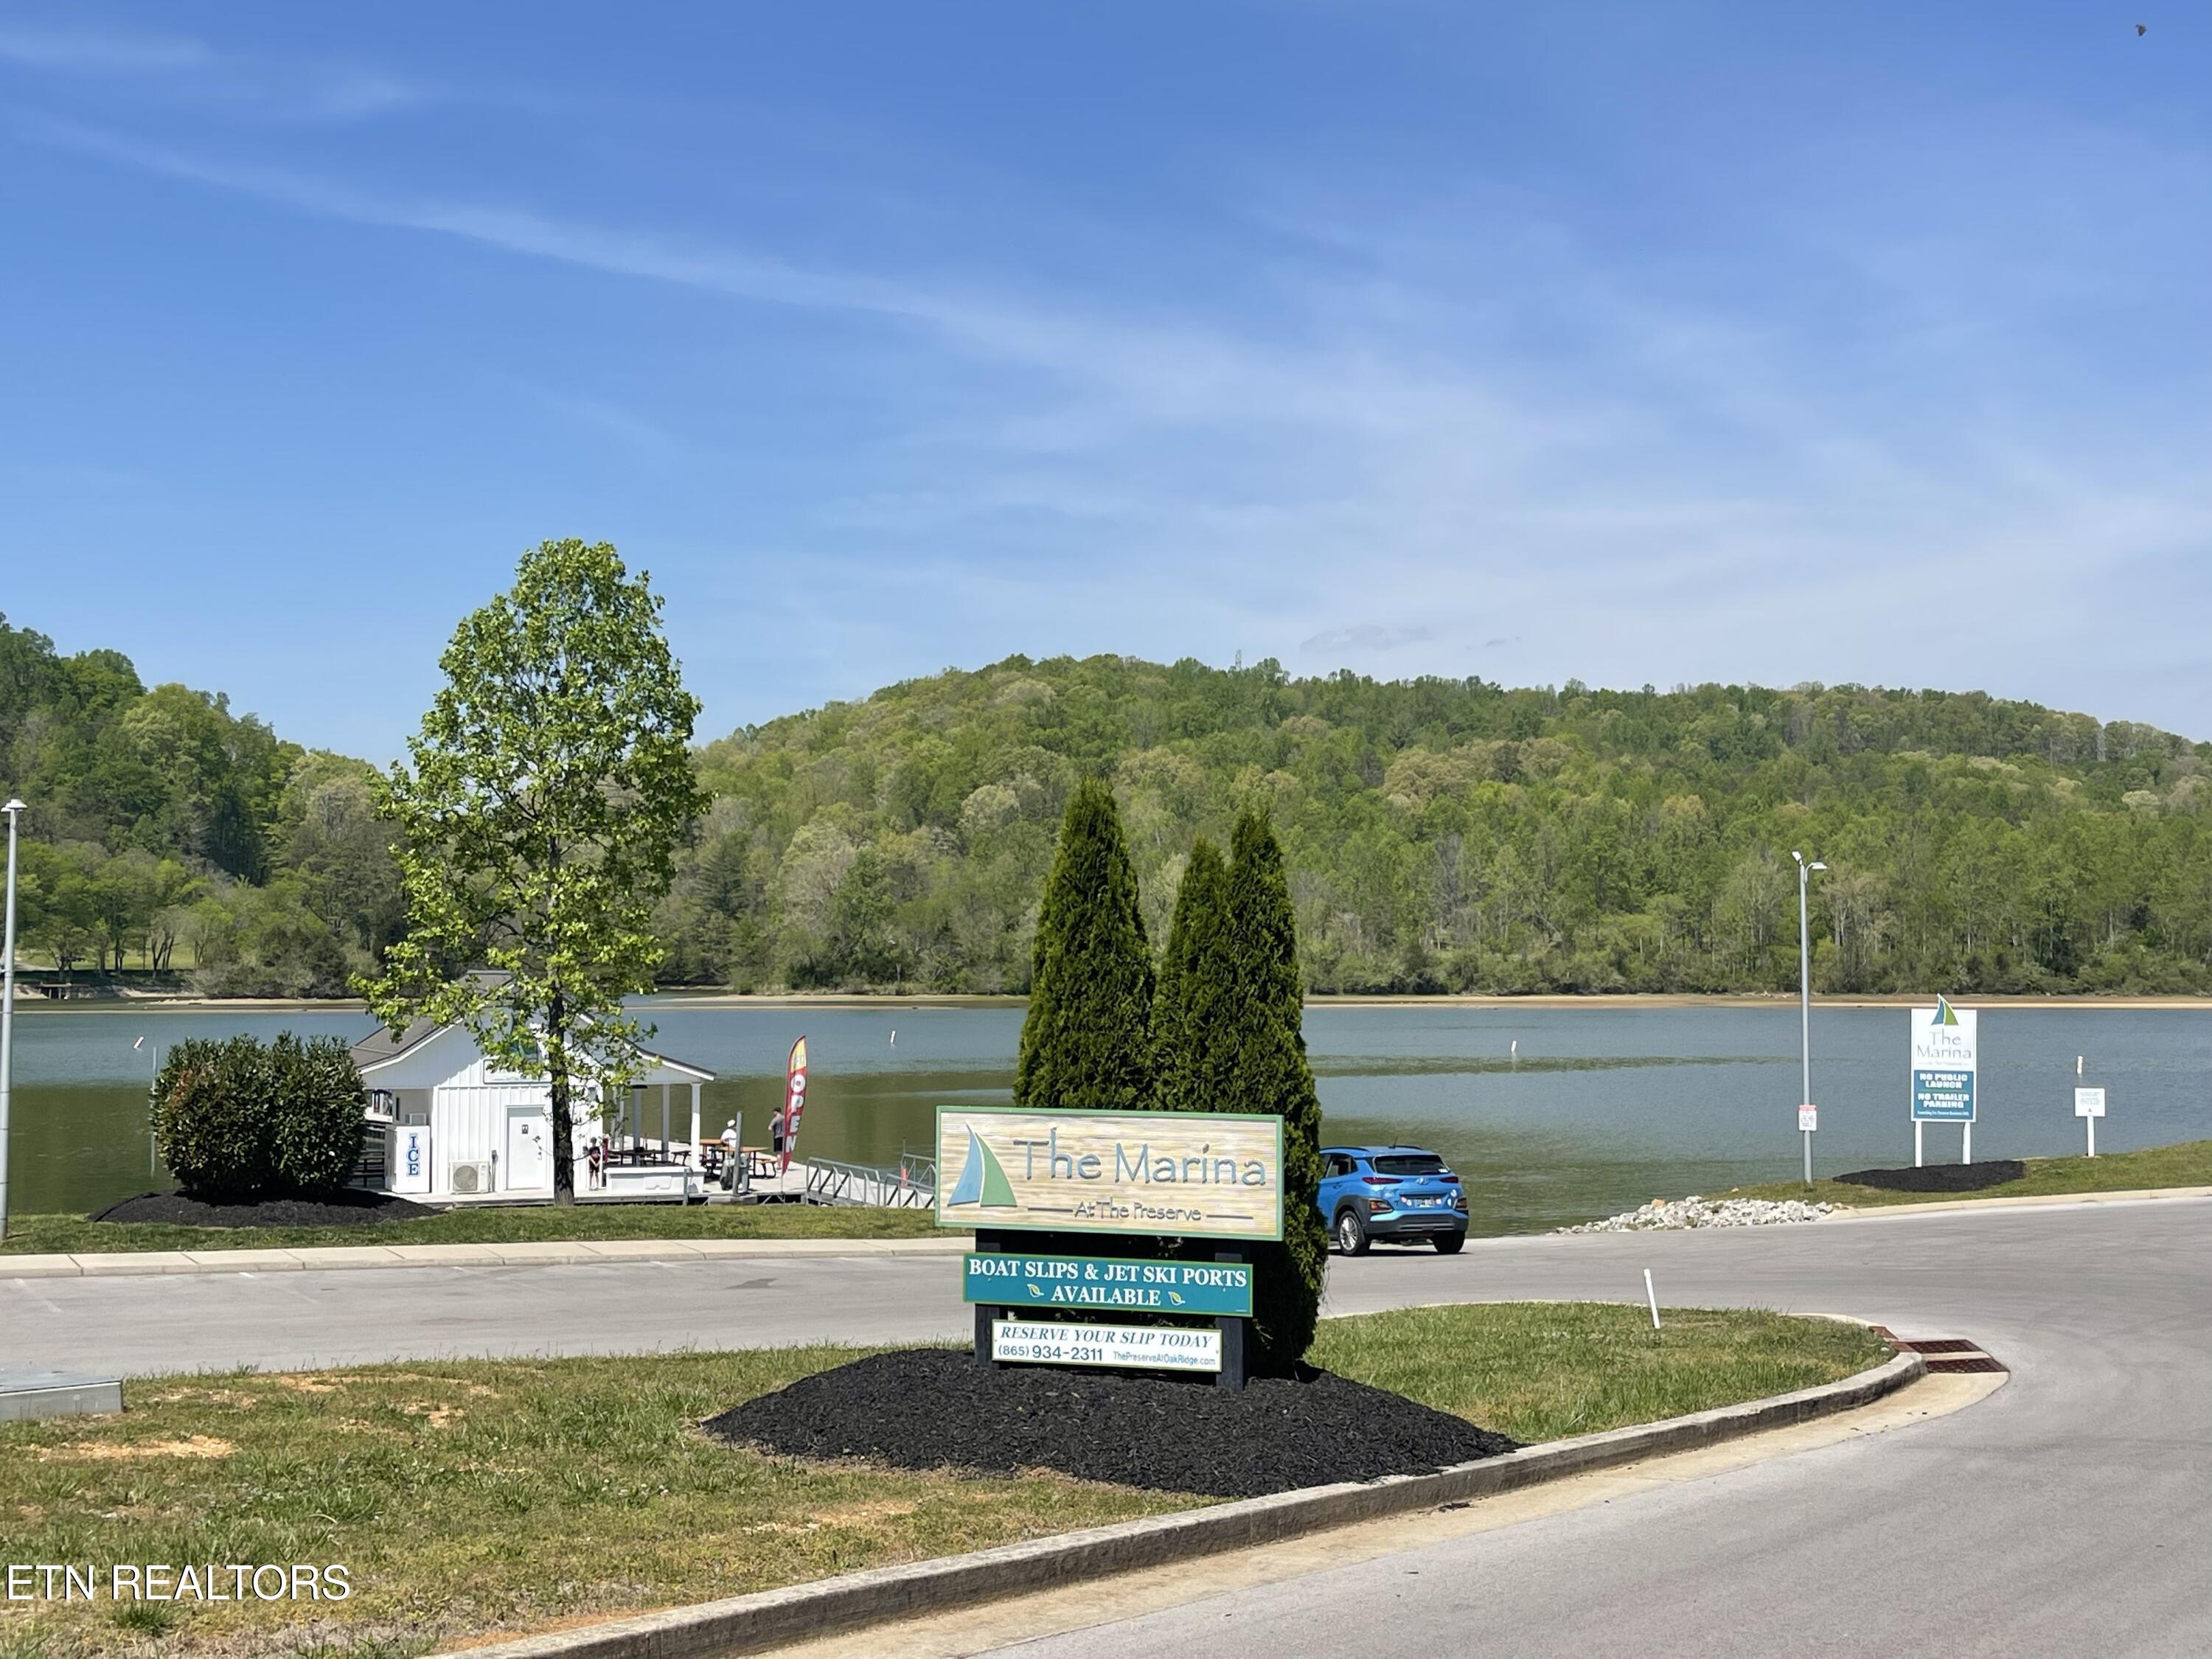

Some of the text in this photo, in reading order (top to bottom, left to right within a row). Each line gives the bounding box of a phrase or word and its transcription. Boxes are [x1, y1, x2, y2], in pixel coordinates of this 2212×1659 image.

[1929, 1028, 1962, 1046] The
[1917, 1044, 1972, 1059] Marina
[1925, 1080, 1962, 1089] LAUNCH
[1934, 1074, 1968, 1082] PUBLIC
[1923, 1100, 1964, 1109] PARKING
[1933, 1093, 1969, 1102] TRAILER
[785, 1074, 806, 1153] OPEN
[407, 1133, 420, 1176] ICE
[1013, 1127, 1267, 1186] The Marina
[1074, 1197, 1202, 1221] At The Preserve
[969, 1259, 1247, 1287] BOAT SLIPS & JET SKI PORTS
[1051, 1285, 1161, 1307] AVAILABLE
[1001, 1326, 1213, 1348] RESERVE YOUR SLIP TODAY
[998, 1344, 1216, 1366] (865) 934-2311 ThePreserveAtOakRidge.com
